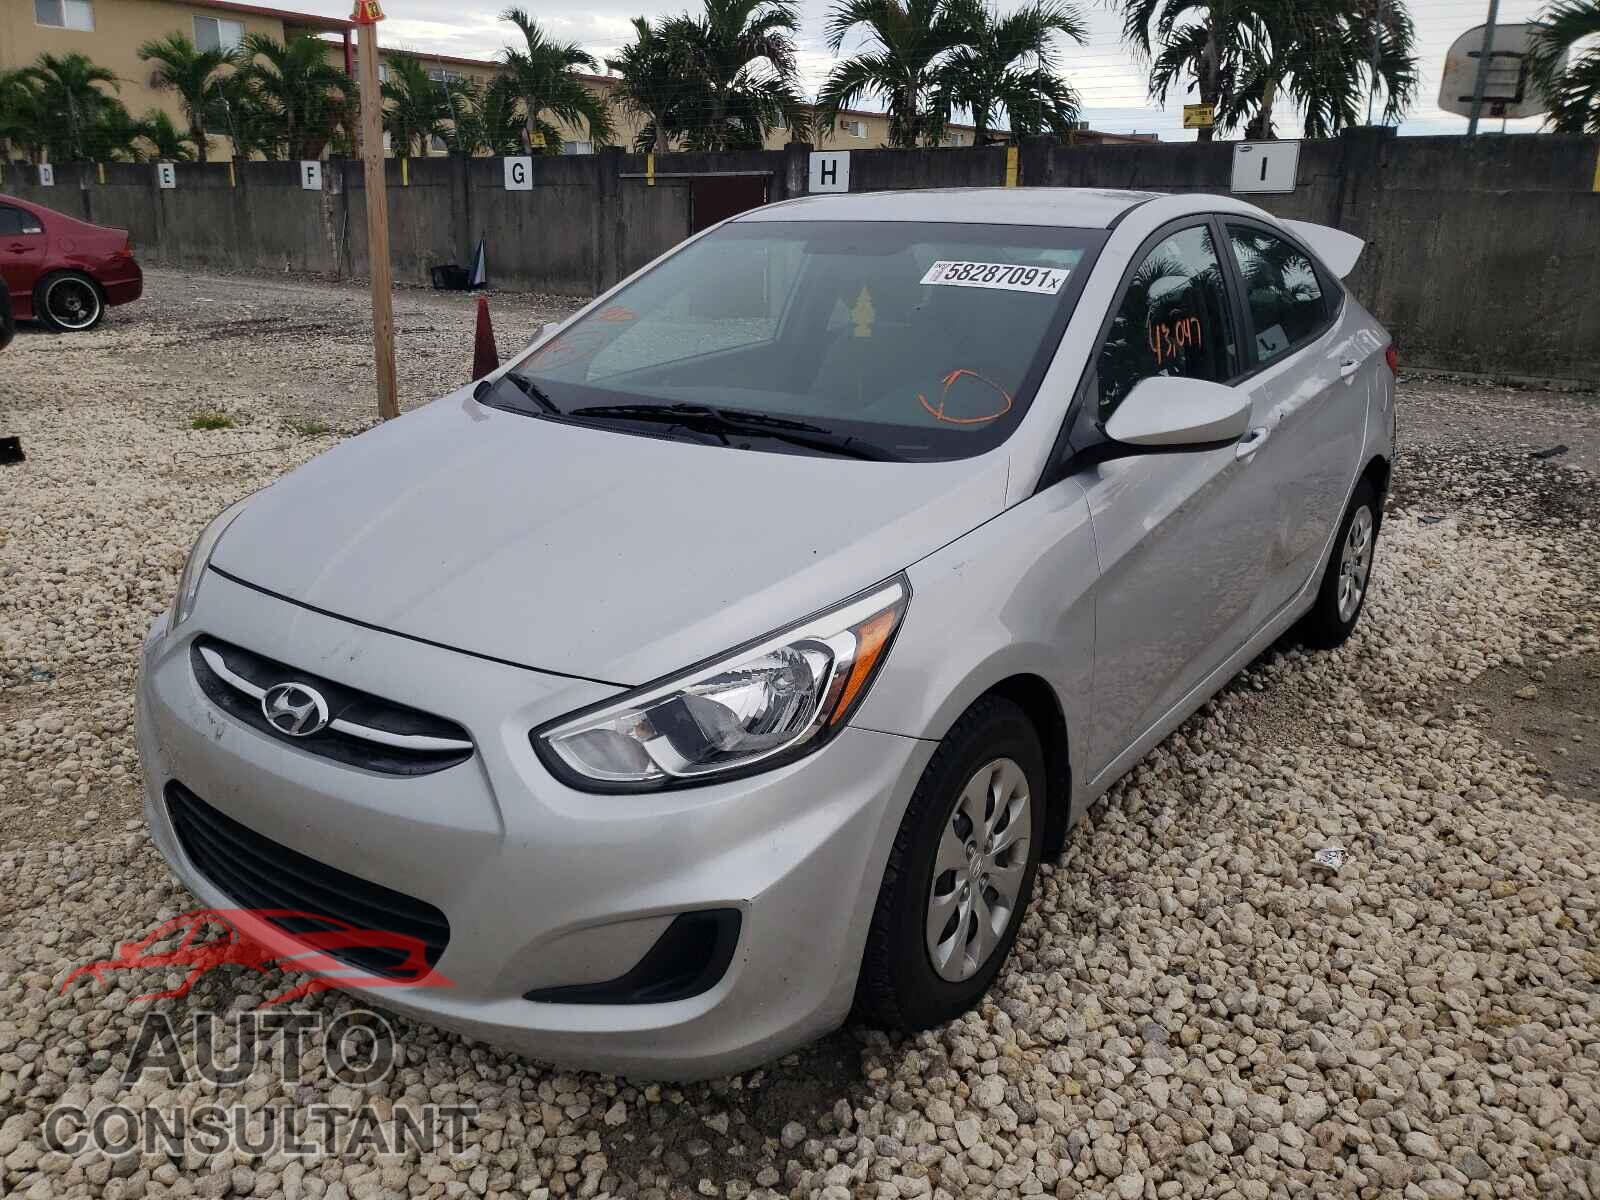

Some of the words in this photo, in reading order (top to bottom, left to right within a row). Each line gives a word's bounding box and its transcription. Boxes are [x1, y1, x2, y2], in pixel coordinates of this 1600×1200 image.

[163, 168, 171, 184] E
[307, 166, 314, 184] F
[512, 162, 525, 184] G
[821, 159, 837, 185] H
[1260, 157, 1267, 181] I
